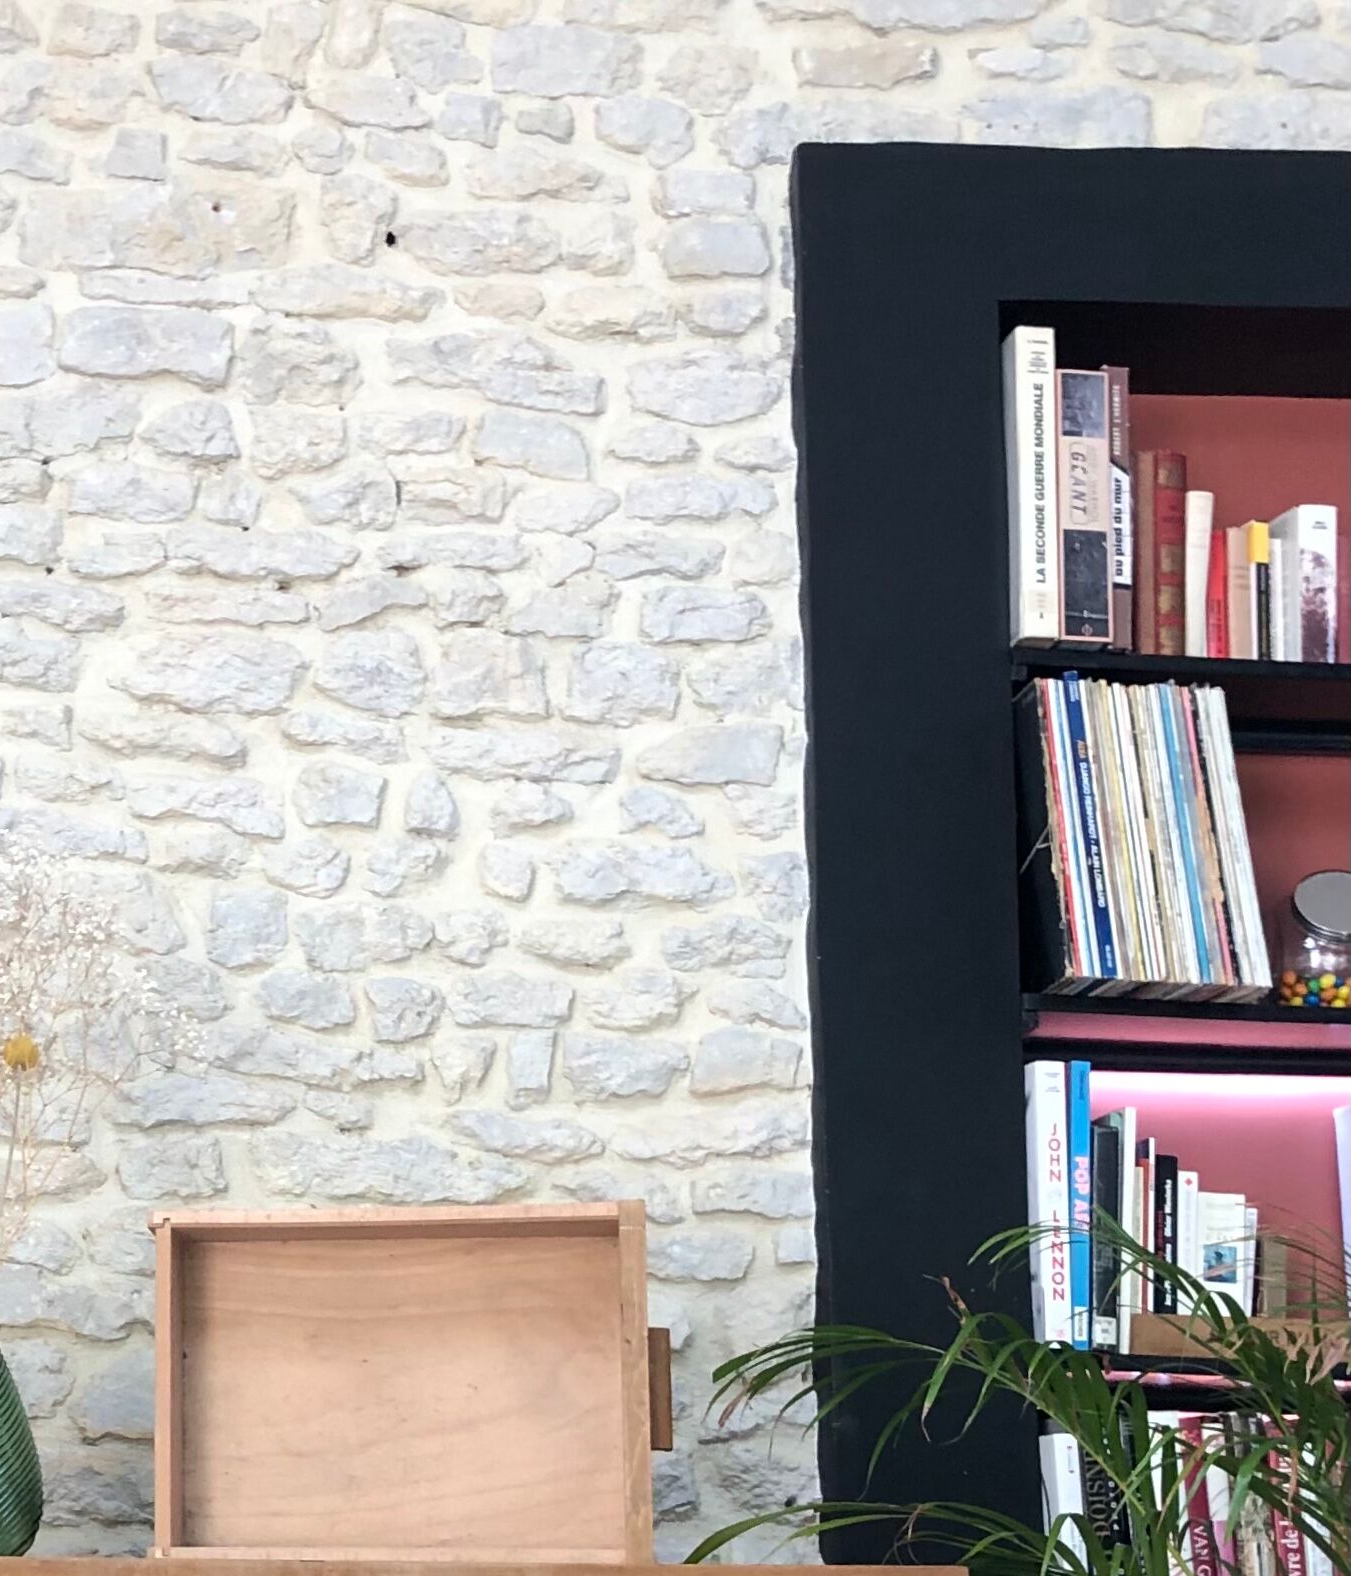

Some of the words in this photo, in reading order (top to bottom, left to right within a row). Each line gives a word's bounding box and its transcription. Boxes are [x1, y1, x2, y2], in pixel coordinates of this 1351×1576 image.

[1033, 383, 1045, 449] MONDIALE
[1034, 452, 1045, 502] GUERRE
[1113, 477, 1122, 505] mur
[1035, 505, 1046, 564] SECONDE
[1113, 507, 1122, 525] du
[1113, 527, 1124, 557] pied
[1036, 567, 1046, 584] LA
[1048, 1123, 1061, 1183] JOHN
[1074, 1156, 1090, 1195] POP
[1052, 1209, 1065, 1301] LENNON
[1193, 1525, 1210, 1561] VAN
[1281, 1529, 1299, 1550] de
